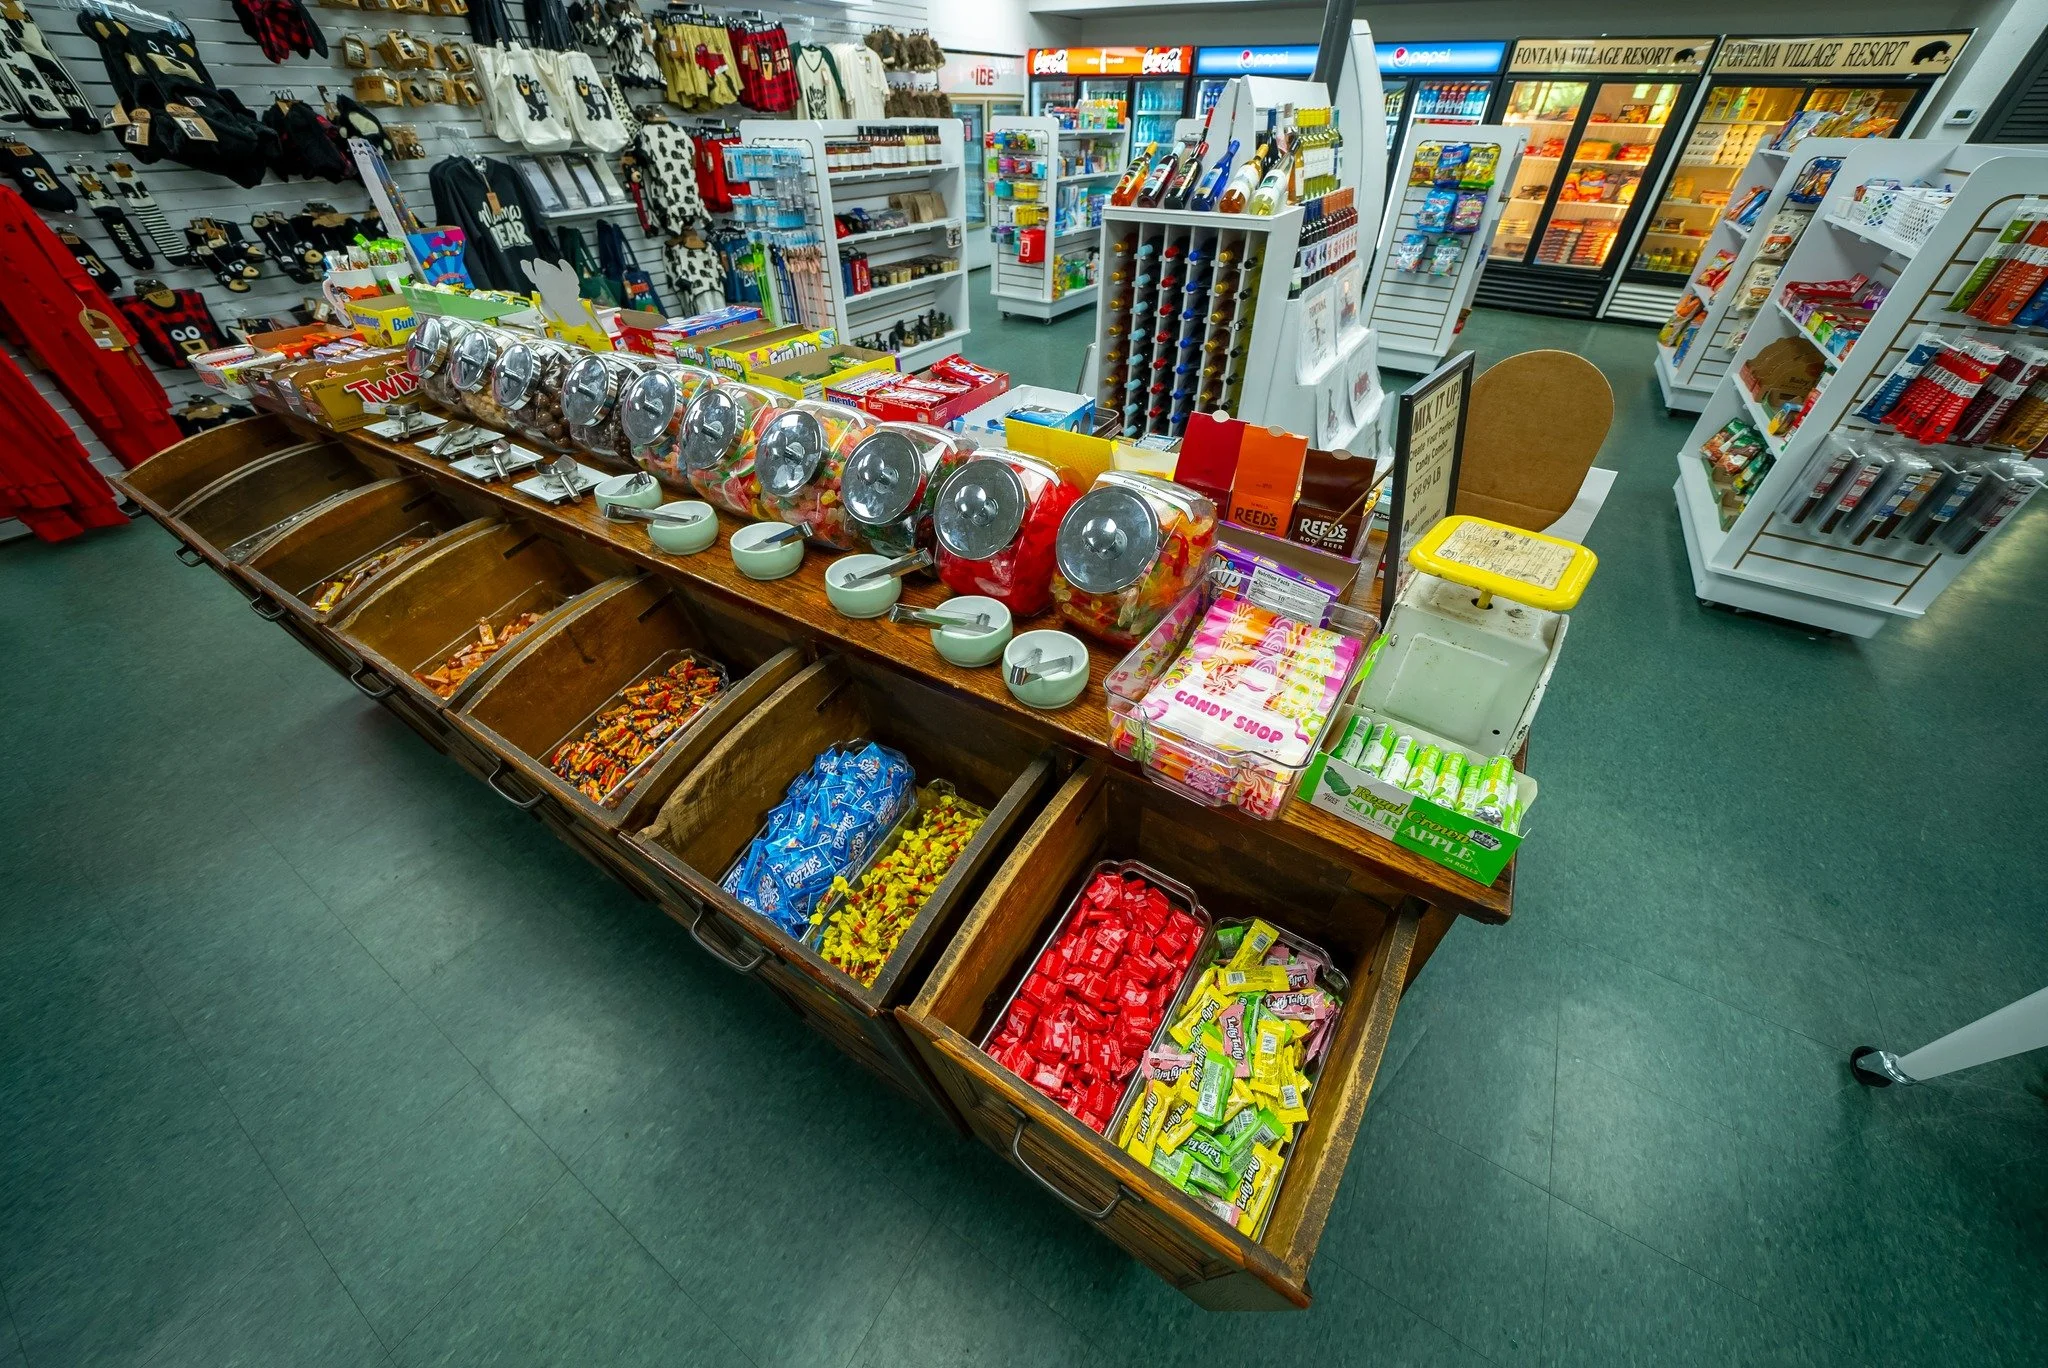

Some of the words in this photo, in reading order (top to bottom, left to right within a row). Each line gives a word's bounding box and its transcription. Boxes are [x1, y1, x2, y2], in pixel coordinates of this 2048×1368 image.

[1254, 51, 1289, 67] pepsi
[1409, 50, 1452, 67] pepsi
[1514, 47, 1567, 65] FONTANA
[1571, 46, 1623, 65] VILLAGE
[1621, 46, 1674, 64] RESORT
[1718, 43, 1781, 67] FONTANA
[1782, 43, 1843, 67] VILLAGE
[1842, 41, 1910, 67] RESORT
[975, 68, 994, 85] ICE
[674, 345, 690, 359] Fun
[688, 348, 704, 365] Dip
[712, 354, 727, 367] Fun
[725, 357, 743, 375] Dip
[769, 346, 795, 365] Fun
[313, 382, 326, 391] 36
[344, 367, 420, 404] Twix
[1412, 404, 1432, 434] MIX
[1435, 391, 1446, 421] IT
[1445, 378, 1462, 409] UP!
[1409, 440, 1426, 463] Create
[1426, 429, 1439, 447] Your
[1438, 417, 1456, 441] Perfect
[1415, 455, 1430, 475] Candy
[1431, 438, 1449, 461] Combo
[1432, 465, 1442, 487] LB
[1234, 507, 1278, 530] REED'S
[1299, 518, 1348, 543] REED'S
[1323, 541, 1344, 551] BEER
[1257, 569, 1279, 584] Nutrition
[1278, 577, 1291, 587] Facts
[1174, 690, 1234, 722] CANDY
[1233, 715, 1284, 744] SHOP
[1350, 785, 1409, 816] Regal
[1406, 809, 1473, 845] Crown
[1346, 797, 1401, 831] SOUR
[1402, 825, 1477, 863] APPLE
[785, 855, 822, 889] Razzles
[1443, 855, 1454, 865] 24
[1453, 858, 1480, 876] ROLLS
[1201, 1000, 1220, 1022] Laffy
[1265, 993, 1288, 1010] Laffy
[1286, 993, 1314, 1008] Taffy
[1226, 1016, 1239, 1038] Laffy
[1231, 1036, 1244, 1060] Taffy
[1190, 1065, 1203, 1092] Laffy
[1137, 1116, 1151, 1143] Laffy
[1144, 1091, 1159, 1119] Taffy
[1163, 1109, 1182, 1133] Laffy
[1199, 1141, 1222, 1168] Laffy
[1244, 1156, 1261, 1184] Taffy
[1236, 1180, 1254, 1211] Laffy
